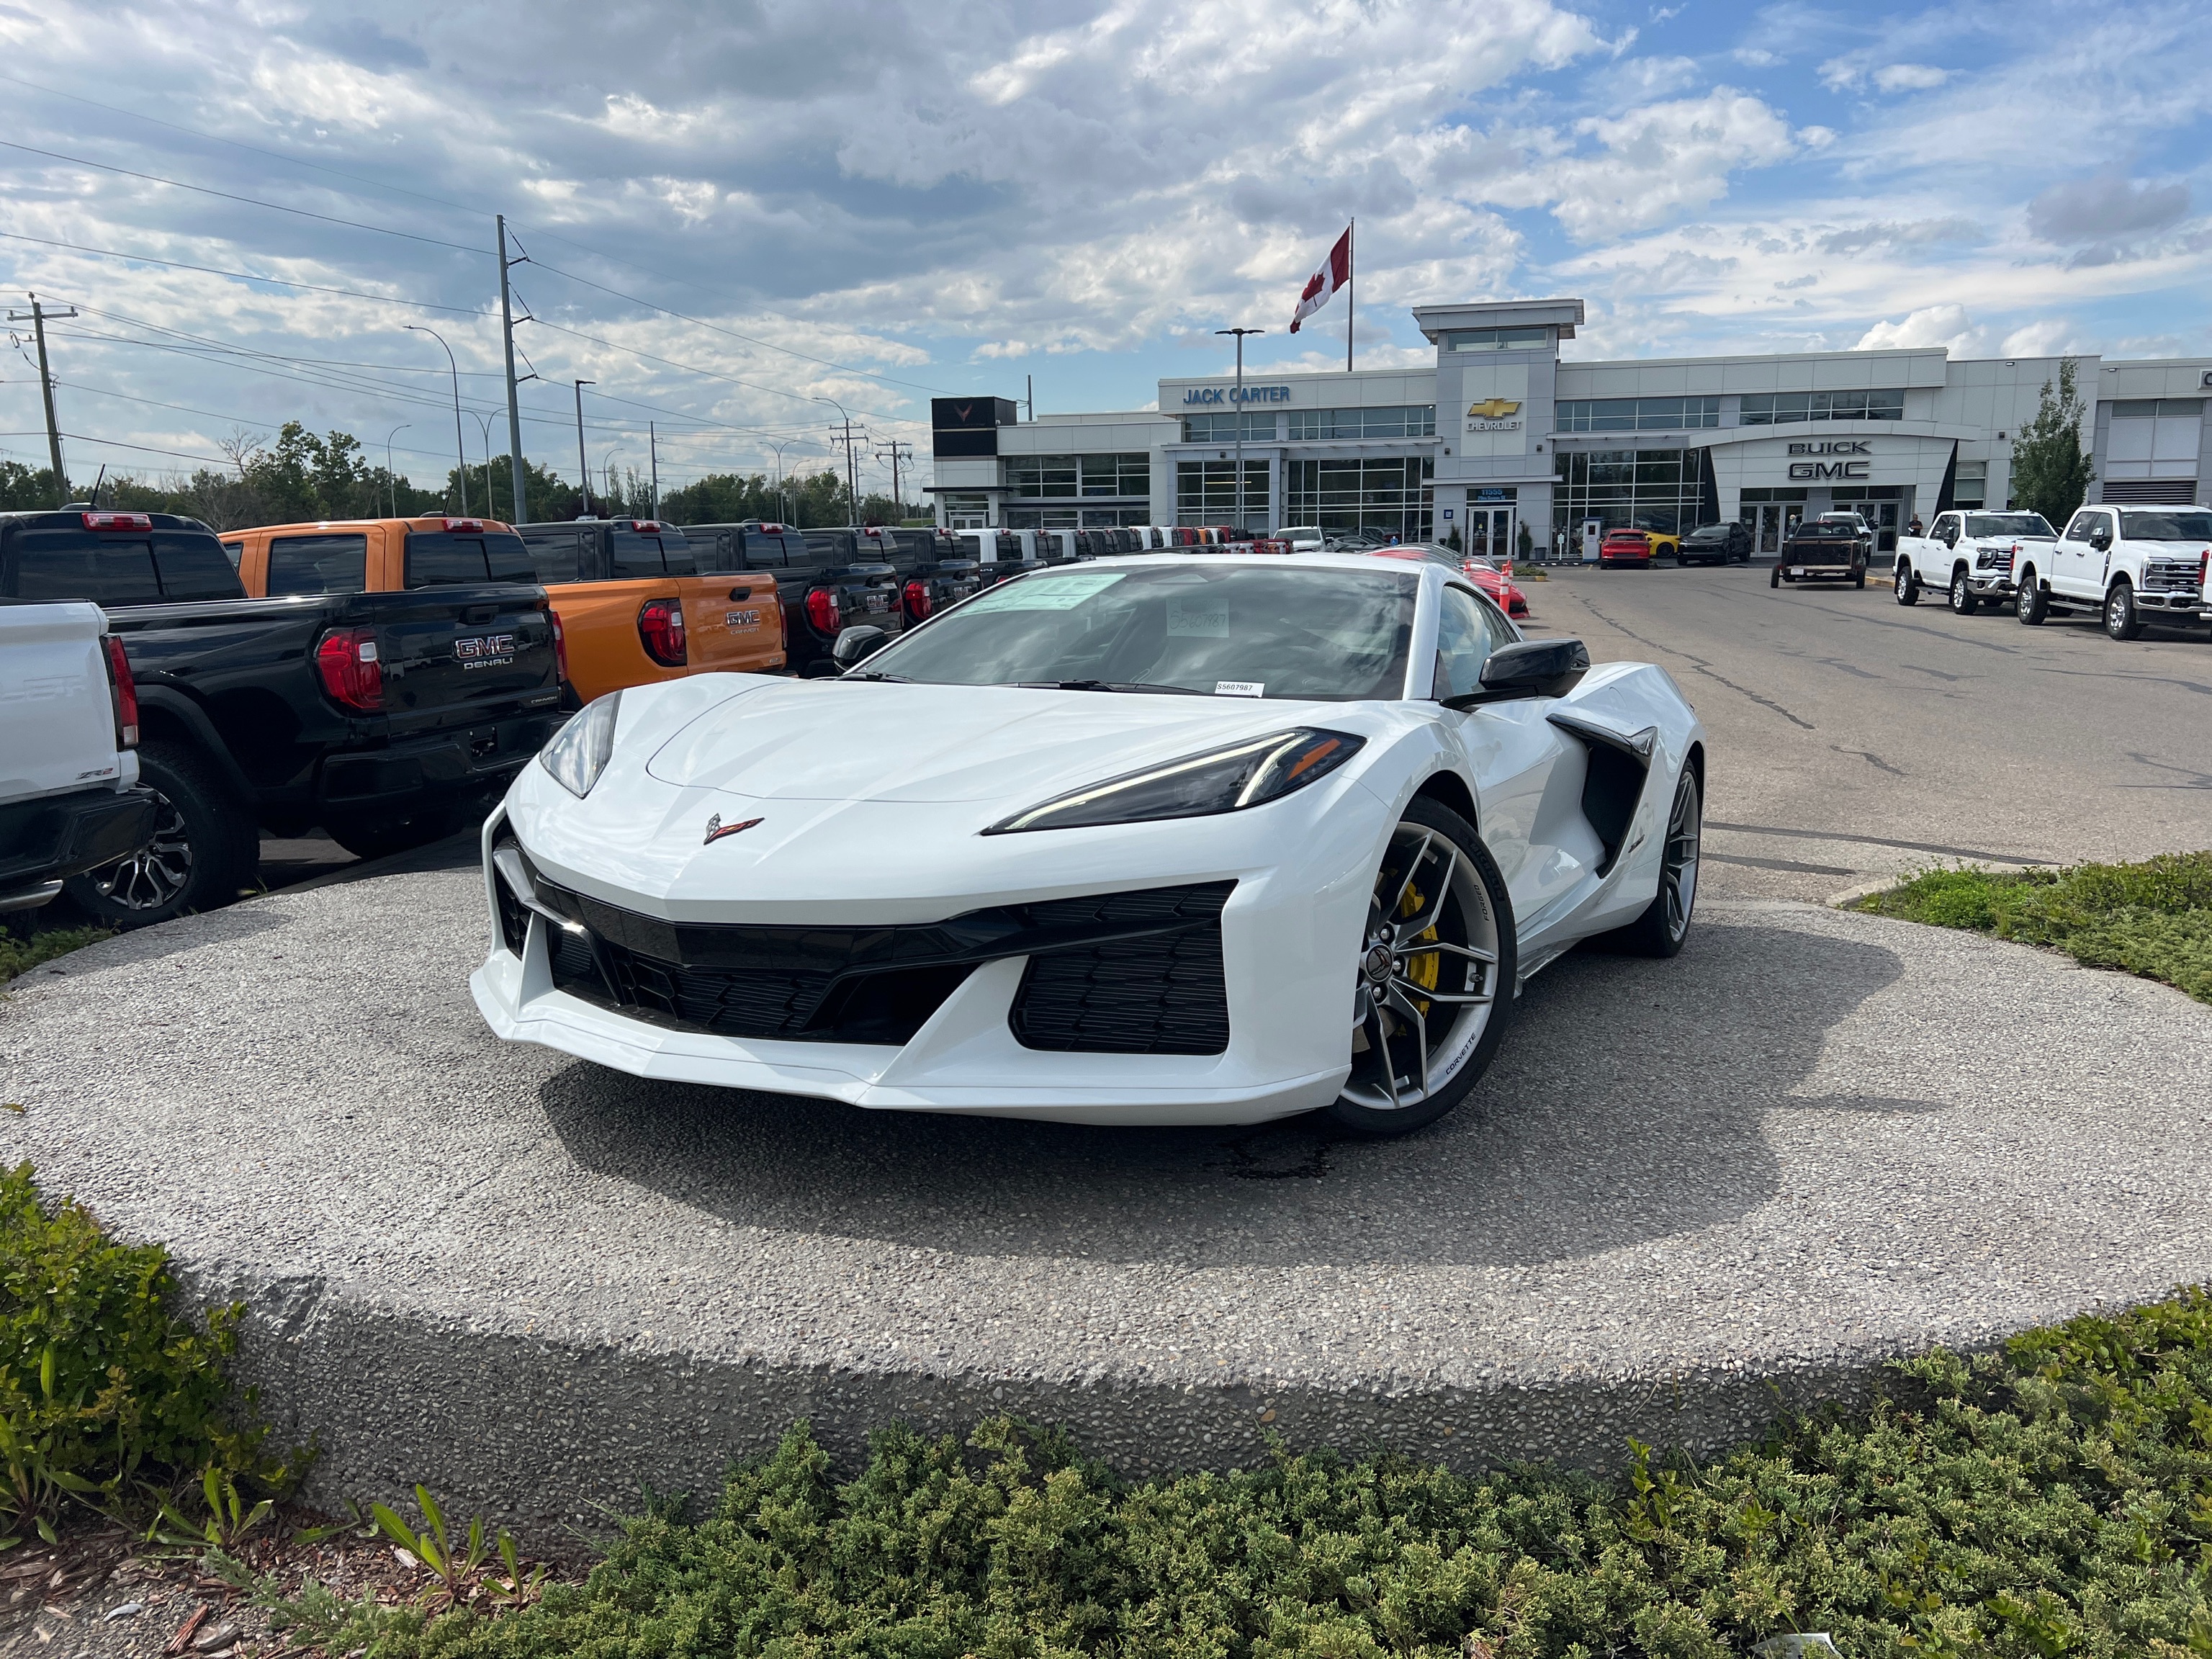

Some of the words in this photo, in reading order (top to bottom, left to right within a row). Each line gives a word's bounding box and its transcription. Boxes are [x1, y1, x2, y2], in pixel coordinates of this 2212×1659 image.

[1183, 389, 1225, 404] JACK
[1229, 386, 1290, 403] CARTER
[1467, 421, 1521, 431] CHEVROLET
[1788, 441, 1871, 455] BUICK
[1788, 461, 1870, 480] GMC
[866, 594, 889, 608] GMC
[727, 610, 760, 627] GMC
[455, 634, 515, 659] GMC
[464, 657, 513, 670] DENALI
[1217, 683, 1254, 692] S5607987
[76, 768, 113, 780] ZR2
[1473, 884, 1490, 922] FORGED
[1445, 1032, 1476, 1075] CORVETTE
